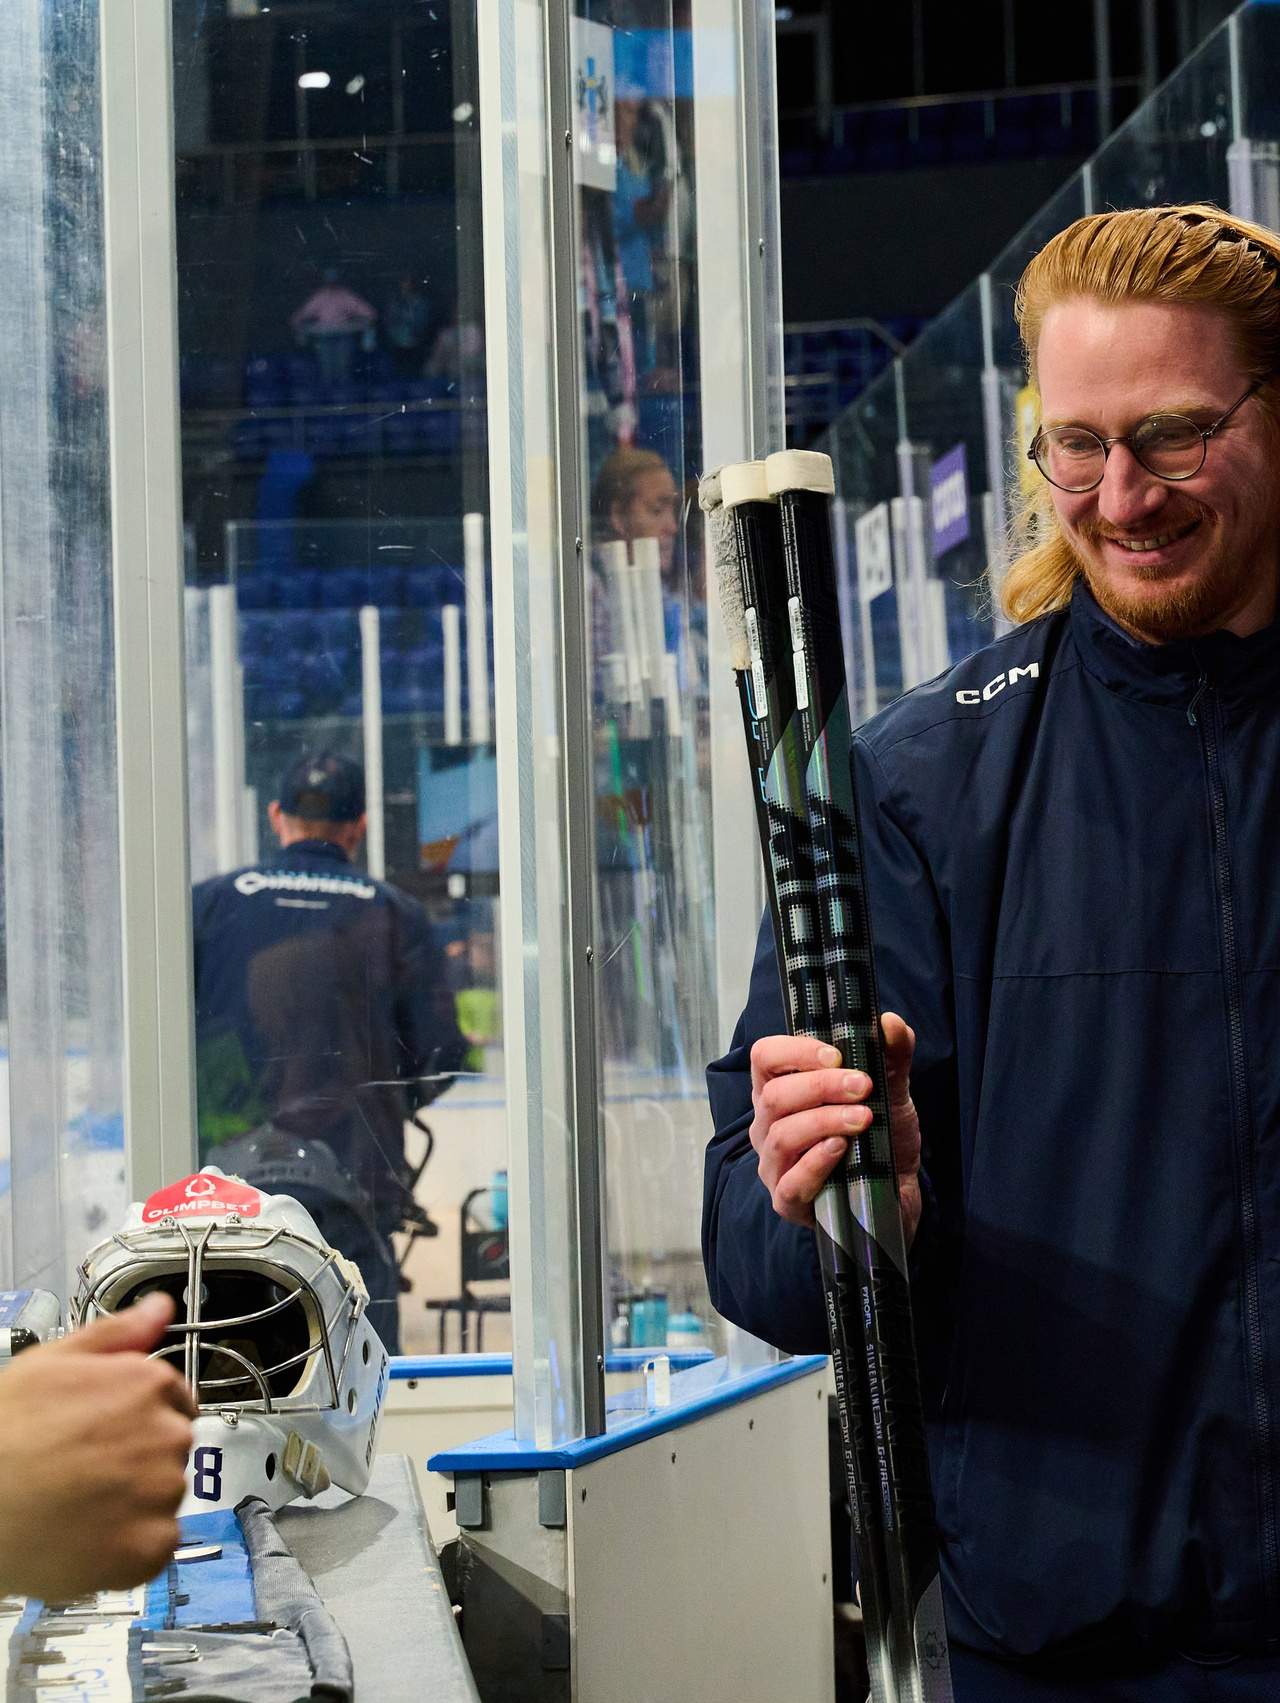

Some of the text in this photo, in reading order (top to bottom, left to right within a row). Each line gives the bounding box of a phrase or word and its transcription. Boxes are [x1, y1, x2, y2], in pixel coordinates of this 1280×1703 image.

[956, 662, 1039, 705] CCM
[147, 1200, 252, 1219] OLIMPBET
[862, 1285, 872, 1329] PYROFIL
[827, 1291, 838, 1333] PYROFIL
[833, 1348, 848, 1415] SILVERLINE
[866, 1343, 881, 1412] SILVERLINE
